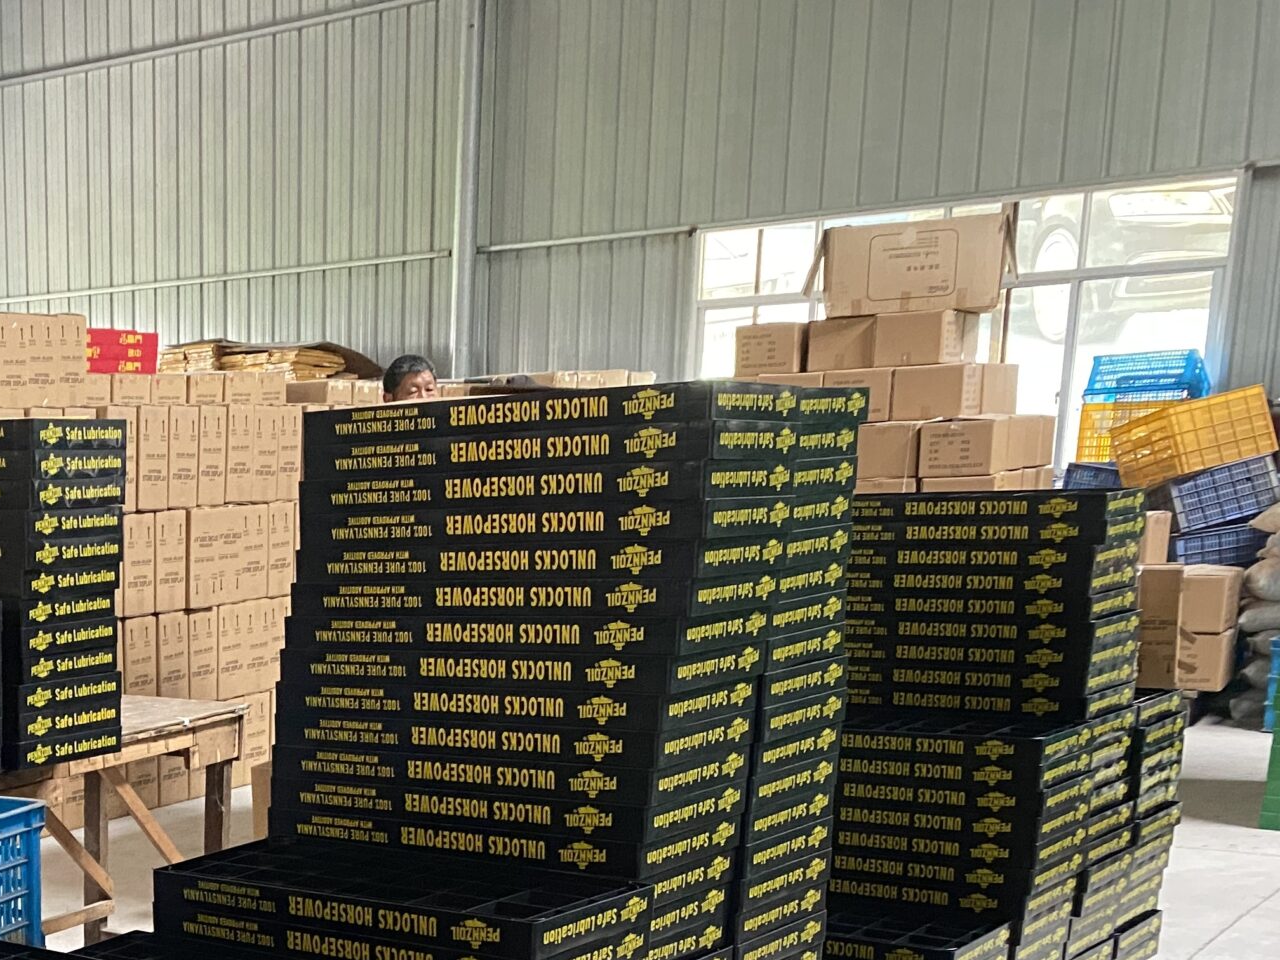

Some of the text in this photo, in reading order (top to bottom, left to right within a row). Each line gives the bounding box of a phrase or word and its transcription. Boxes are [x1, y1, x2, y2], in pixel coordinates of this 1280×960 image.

[717, 392, 774, 411] Safe Lubrication
[376, 409, 403, 418] APPROVED
[405, 407, 419, 416] WITH
[450, 396, 675, 427] PENNZOIL UNLOCKS HORSEPOWER
[65, 427, 82, 440] Safe
[83, 426, 122, 440] Lubrication
[334, 417, 436, 435] 100% PURE PENNSYLVANIA
[445, 472, 669, 500] PENNZOIL UNLOCKS HORSEPOWER
[905, 501, 977, 516] HORSEPOWER
[980, 501, 1029, 516] UNLOCKS
[61, 516, 78, 530] Safe
[79, 514, 118, 528] Lubrication
[427, 623, 645, 645] PENNZOIL UNLOCKS HORSEPOWER
[677, 655, 736, 680] Safe Lubrication
[55, 681, 117, 701] Safe Lubrication
[305, 696, 401, 711] 100% PURE PENNSYLVANIA
[841, 734, 913, 751] HORSEPOWER
[916, 738, 965, 755] UNLOCKS
[401, 827, 607, 863] PENNZOIL UNLOCKS HORSEPOWER
[596, 908, 617, 927] Safe
[543, 916, 595, 945] Lubrication
